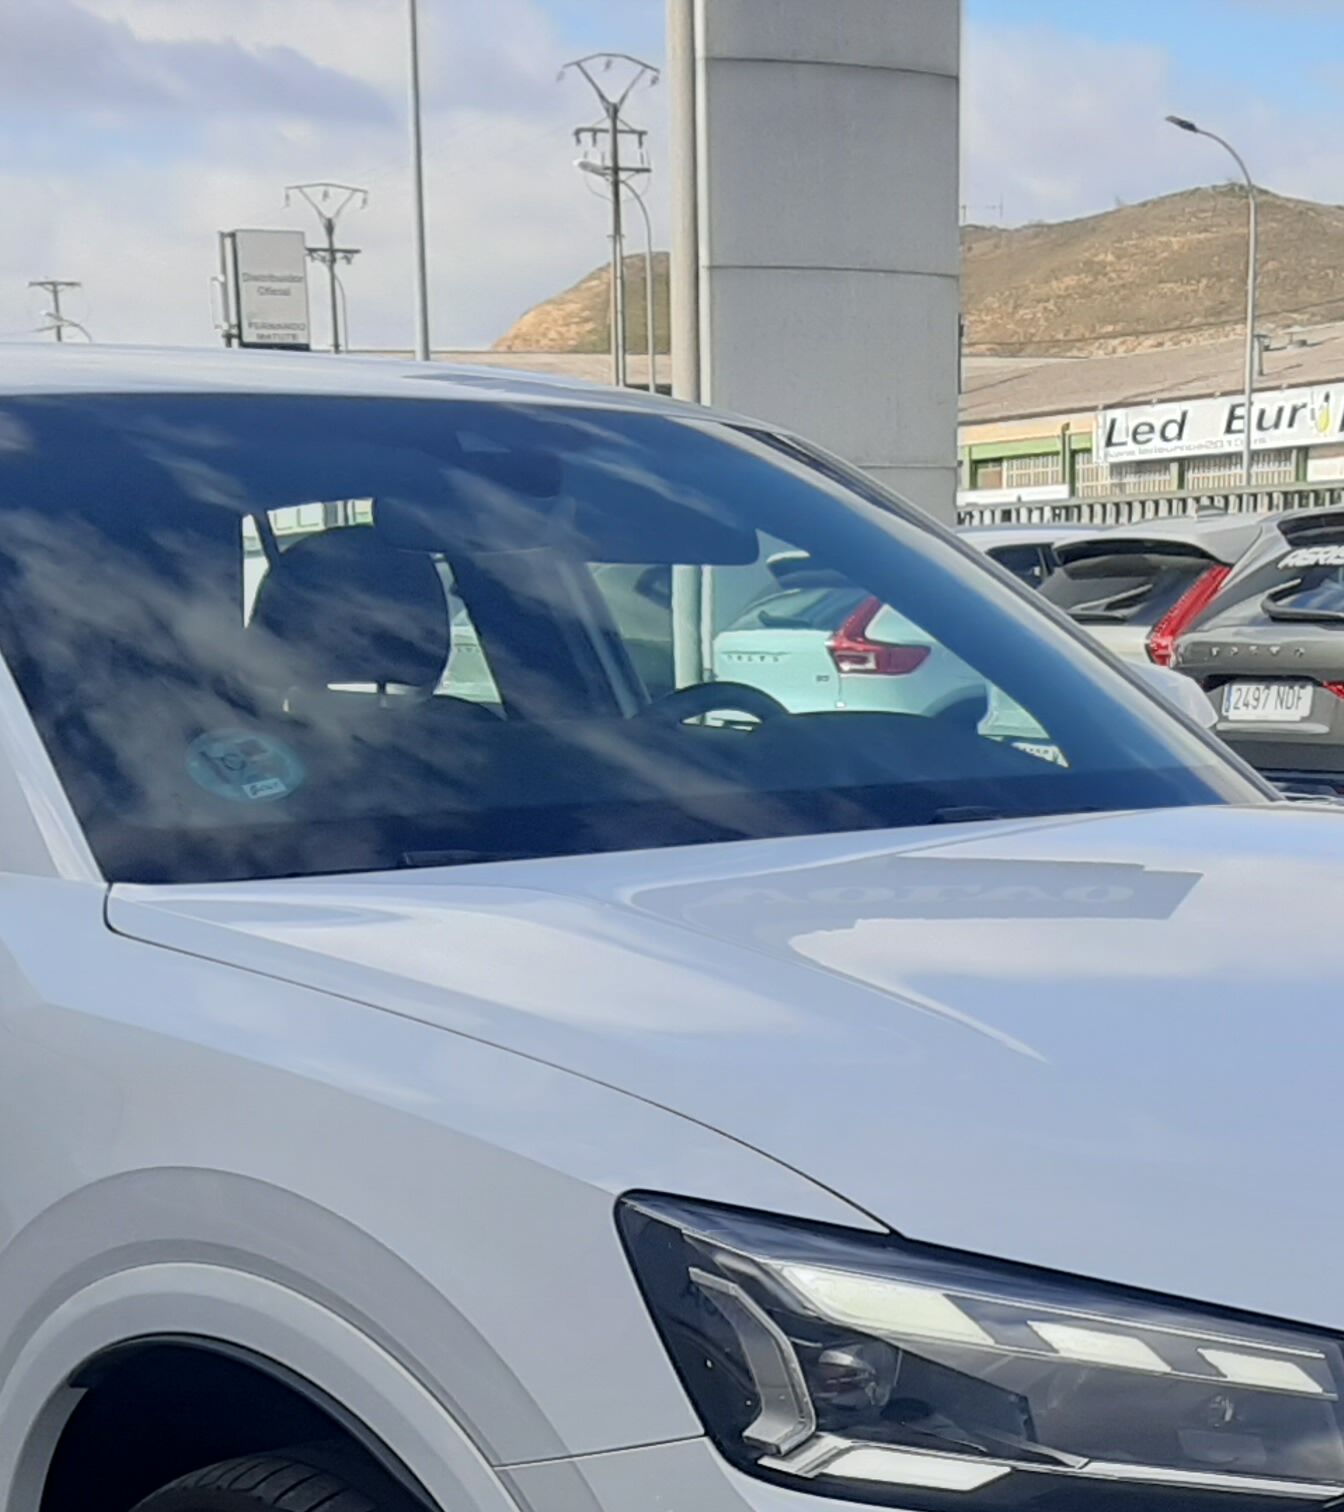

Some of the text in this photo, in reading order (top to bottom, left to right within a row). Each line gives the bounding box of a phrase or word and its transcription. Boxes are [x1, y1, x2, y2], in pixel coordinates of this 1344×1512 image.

[1105, 409, 1188, 448] Led
[1233, 685, 1304, 712] 2497 NDF
